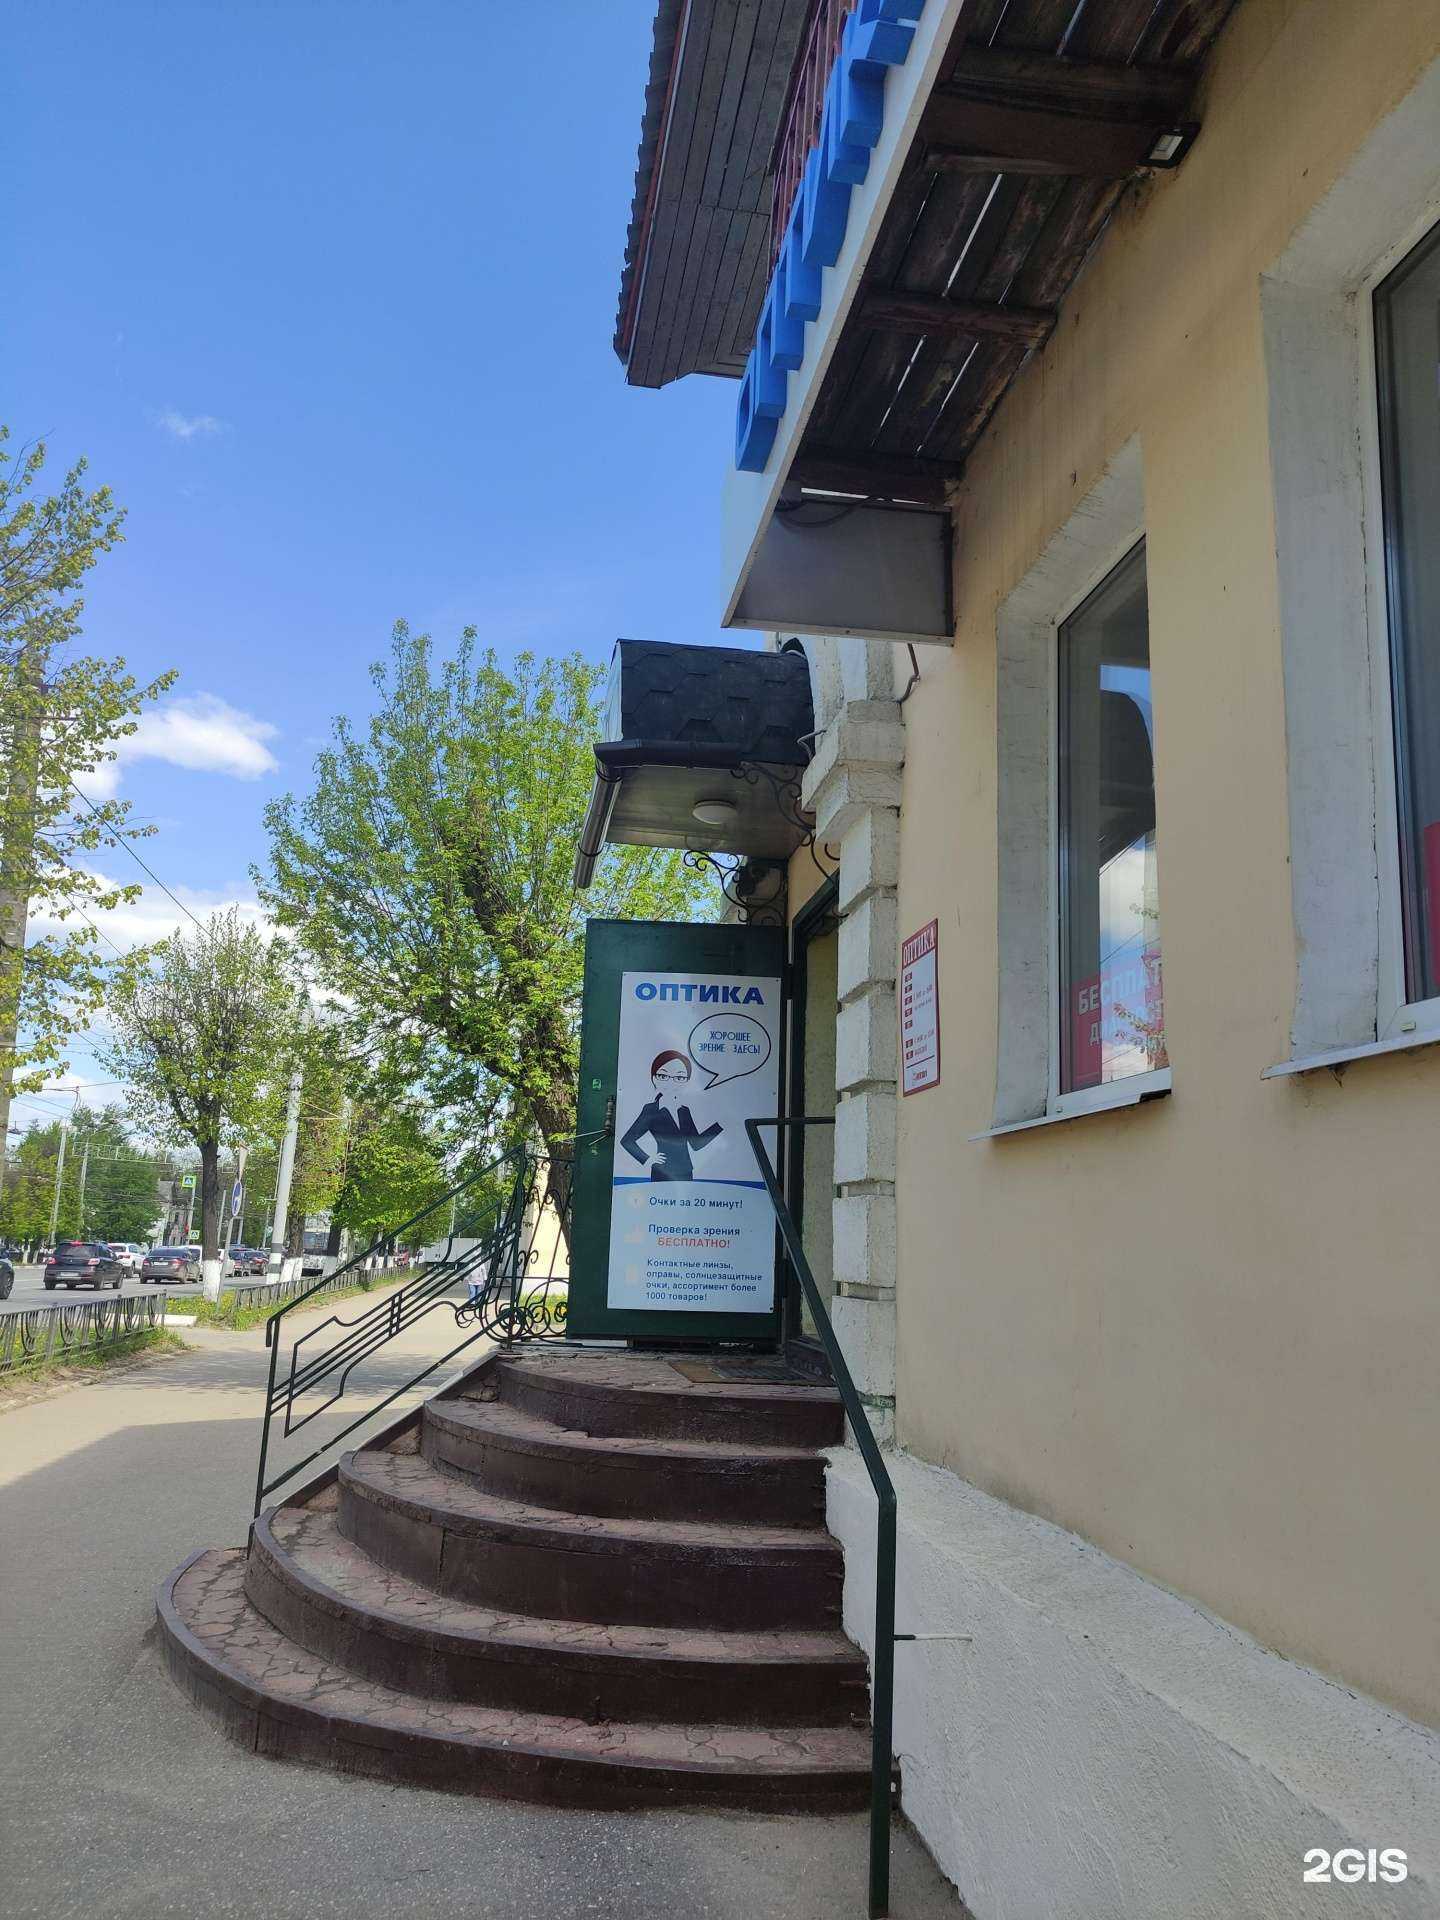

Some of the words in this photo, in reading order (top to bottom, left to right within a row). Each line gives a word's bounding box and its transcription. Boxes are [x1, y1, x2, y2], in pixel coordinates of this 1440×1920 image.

[735, 0, 926, 474] ОПТИК
[903, 926, 936, 966] ОПТИКА
[635, 982, 765, 1006] ОПТИКА
[710, 1030, 752, 1042] ХОРОШЕЕ
[698, 1042, 726, 1053] ЗРЕНИЕ
[733, 1043, 761, 1055] ЗДЕСЬ!
[649, 1196, 676, 1207] Очки
[679, 1199, 691, 1207] за
[694, 1198, 706, 1208] 20
[708, 1199, 743, 1210] минут!
[648, 1224, 700, 1236] Проверка
[703, 1227, 740, 1237] зрения
[657, 1237, 731, 1249] БЕСПЛАТНО!
[647, 1258, 701, 1269] Контактные
[702, 1261, 734, 1270] линзы,
[646, 1270, 683, 1280] оправы,
[685, 1272, 763, 1281] солнцезащитные
[646, 1282, 670, 1291] очки,
[672, 1284, 729, 1294] ассортимент
[730, 1283, 757, 1293] более
[646, 1292, 666, 1301] 1000
[668, 1293, 708, 1303] товаров!
